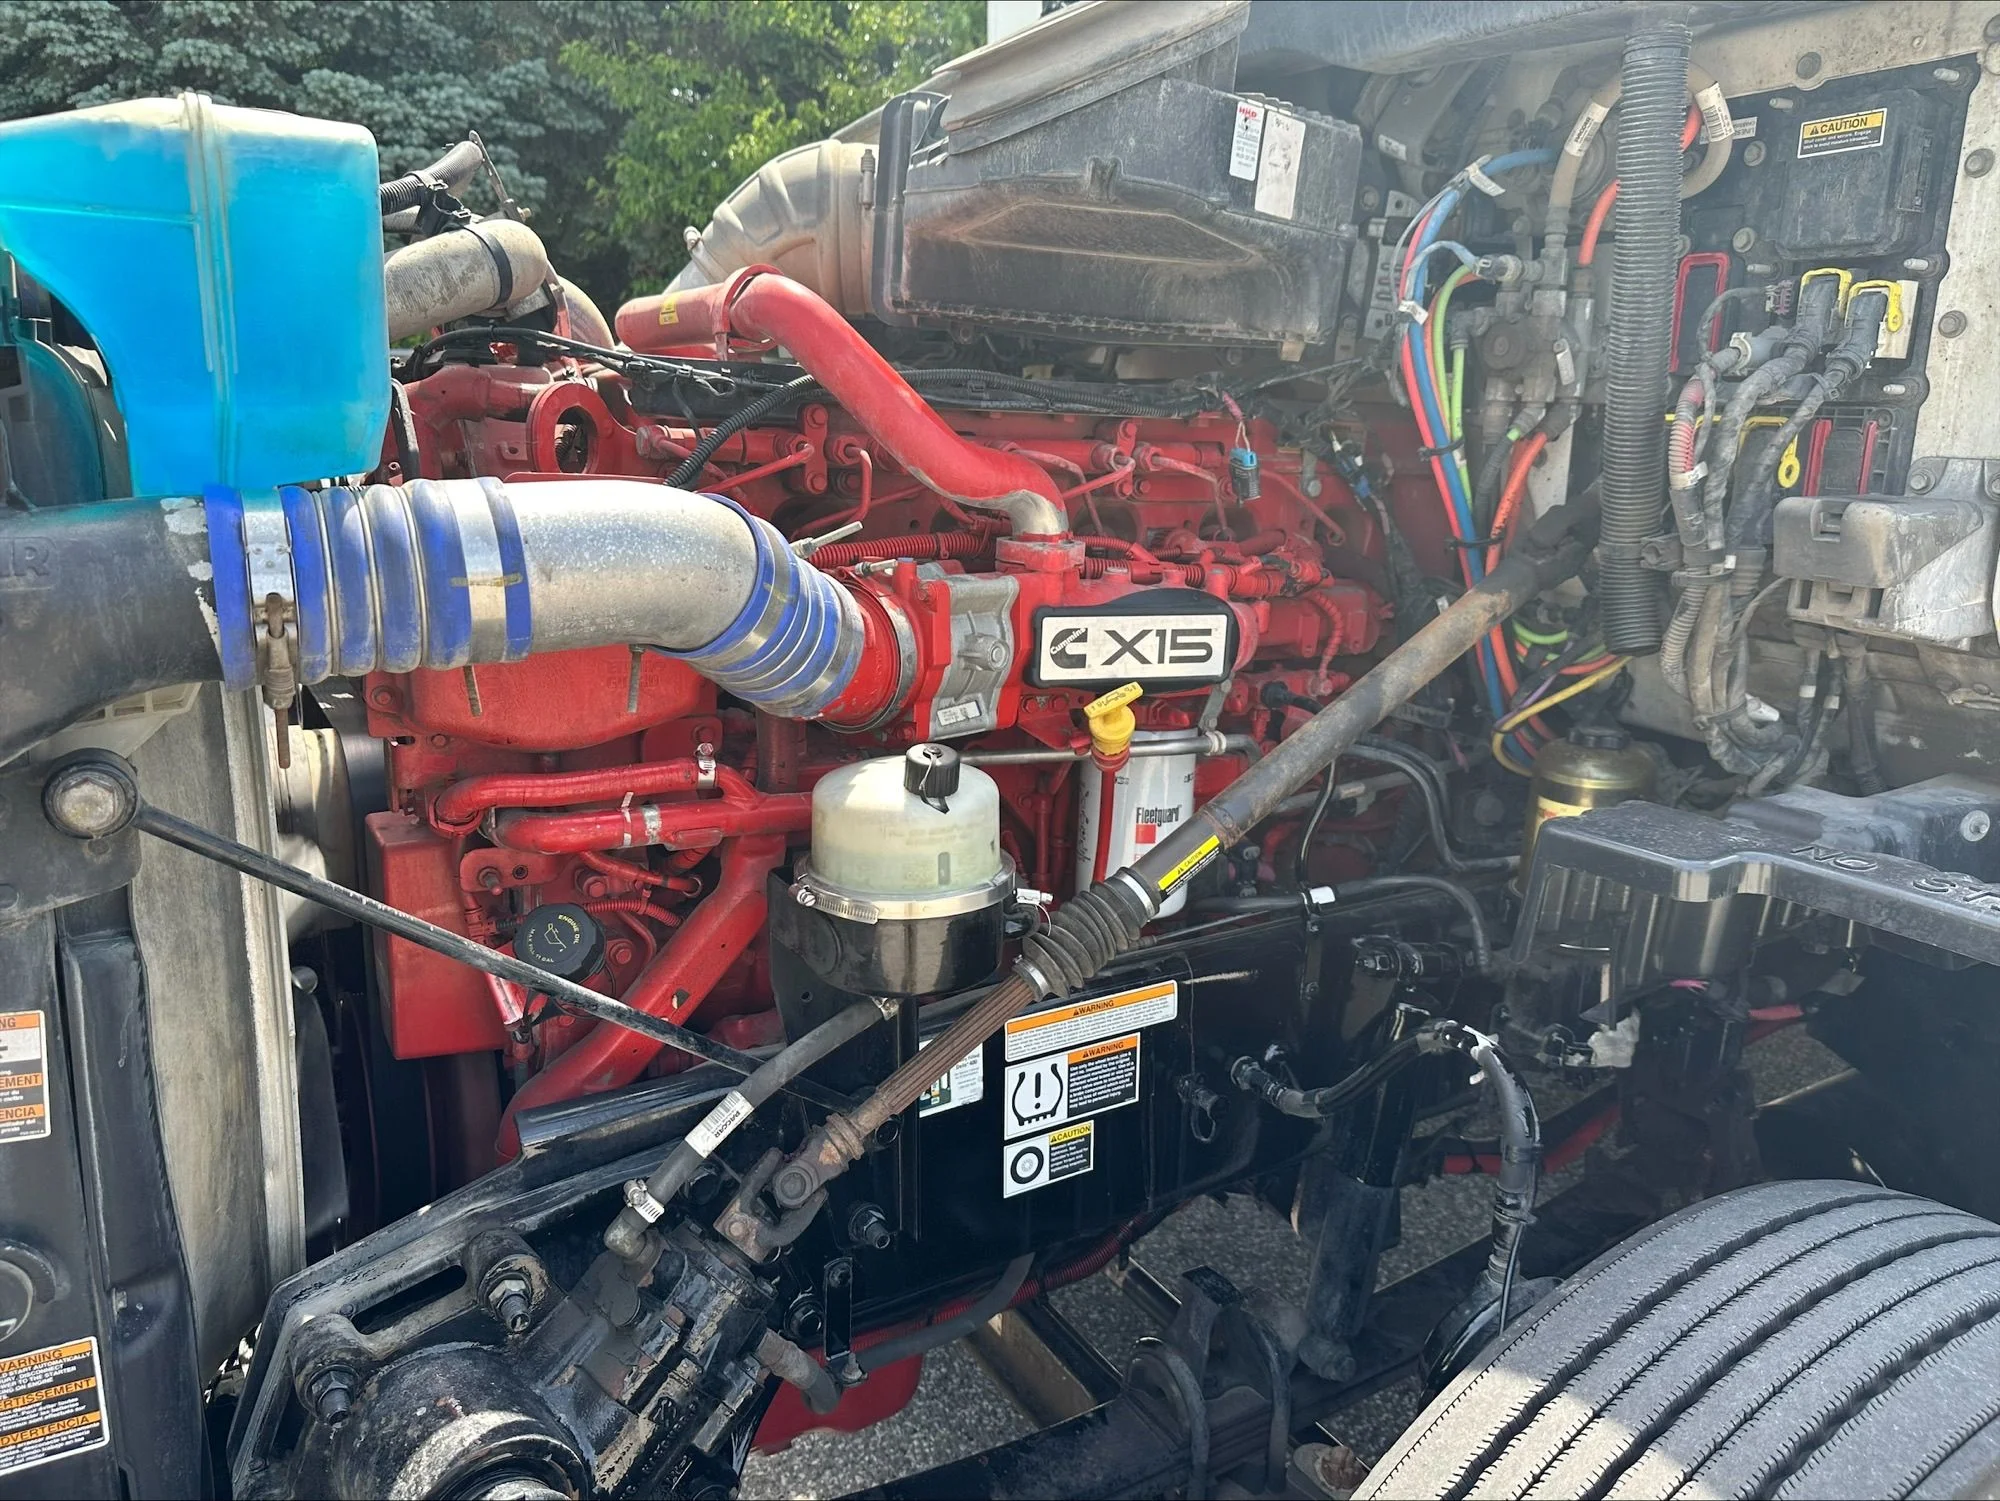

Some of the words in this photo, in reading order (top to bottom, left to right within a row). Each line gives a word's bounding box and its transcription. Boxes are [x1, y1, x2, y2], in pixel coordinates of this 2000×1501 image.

[1821, 117, 1867, 133] CAUTION
[1050, 628, 1086, 655] Cummins
[1101, 628, 1212, 666] X15
[1136, 806, 1179, 827] Fleetguard
[1790, 846, 1878, 871] NO
[558, 914, 580, 932] ENGINE
[1079, 1000, 1114, 1014] WARNING
[1088, 1041, 1124, 1056] WARNING
[714, 1110, 741, 1138] PACCAR
[1058, 1125, 1090, 1140] CAUTION
[8, 1367, 32, 1377] START
[19, 1364, 64, 1379] DISCONNECT
[44, 1365, 77, 1379] STARTER
[0, 1415, 89, 1445] DVERTENCIA
